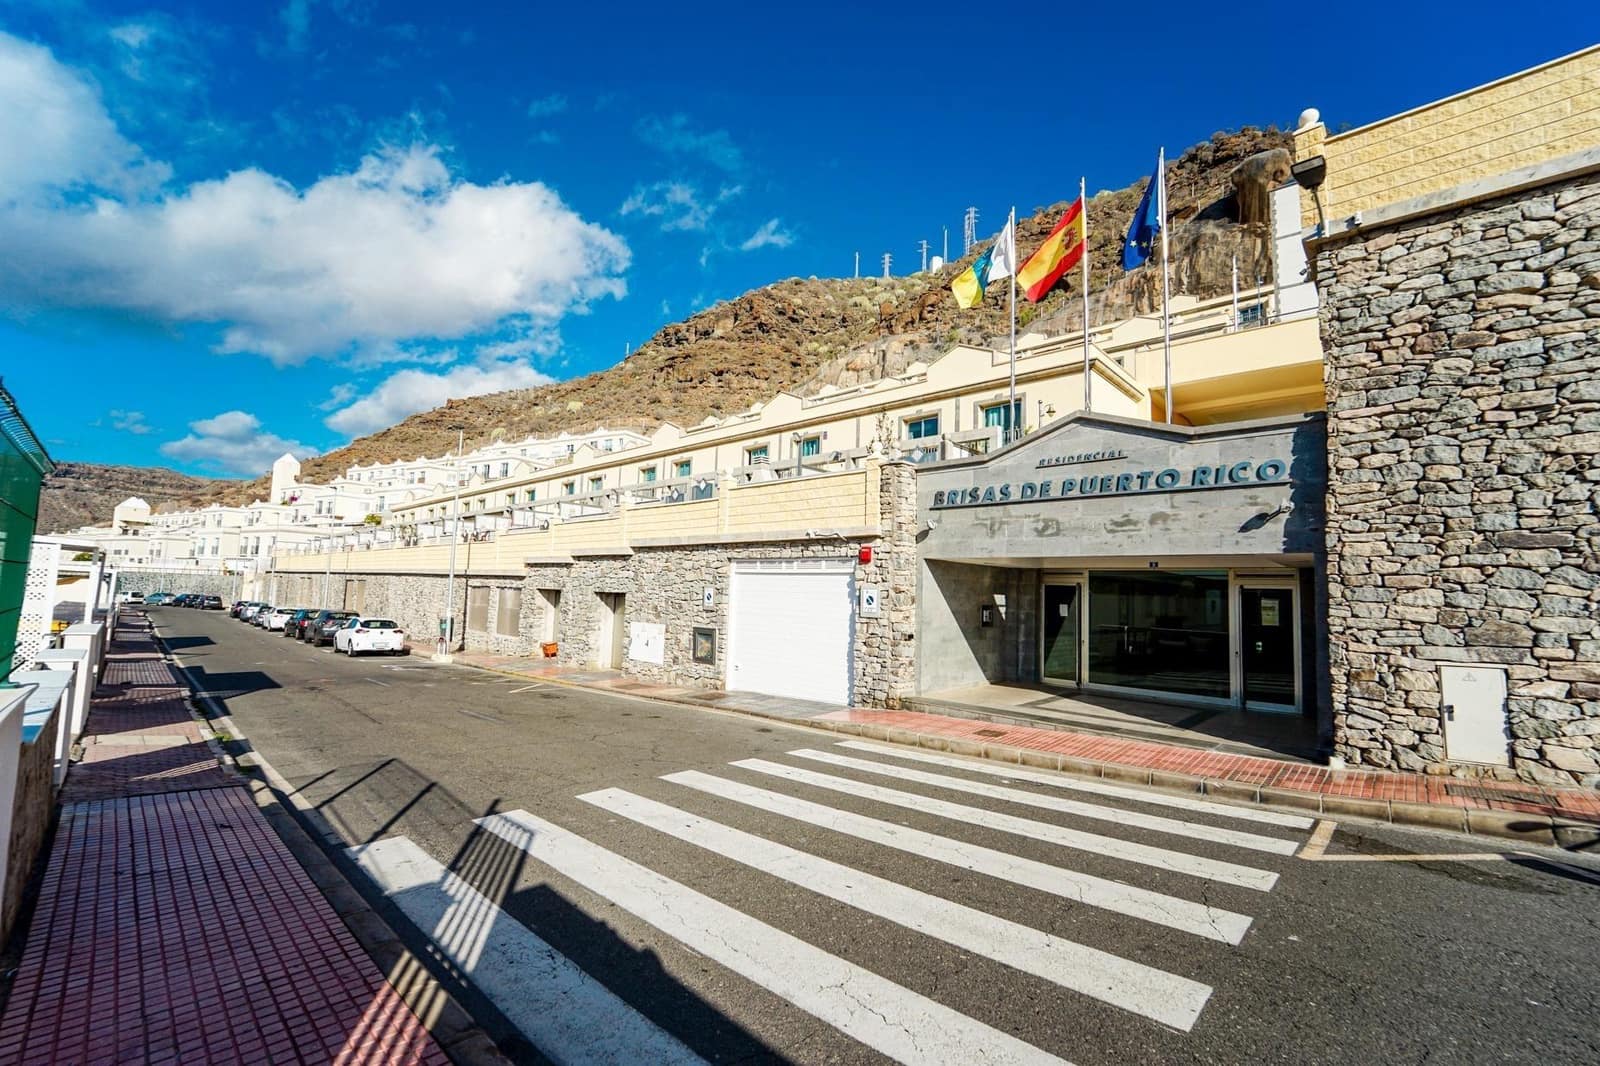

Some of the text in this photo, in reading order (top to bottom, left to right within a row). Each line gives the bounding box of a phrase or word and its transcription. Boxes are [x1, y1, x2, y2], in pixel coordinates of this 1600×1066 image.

[1039, 449, 1124, 466] RESIDENCIAL
[933, 458, 1287, 507] BRISAS DE PUERTO RICO
